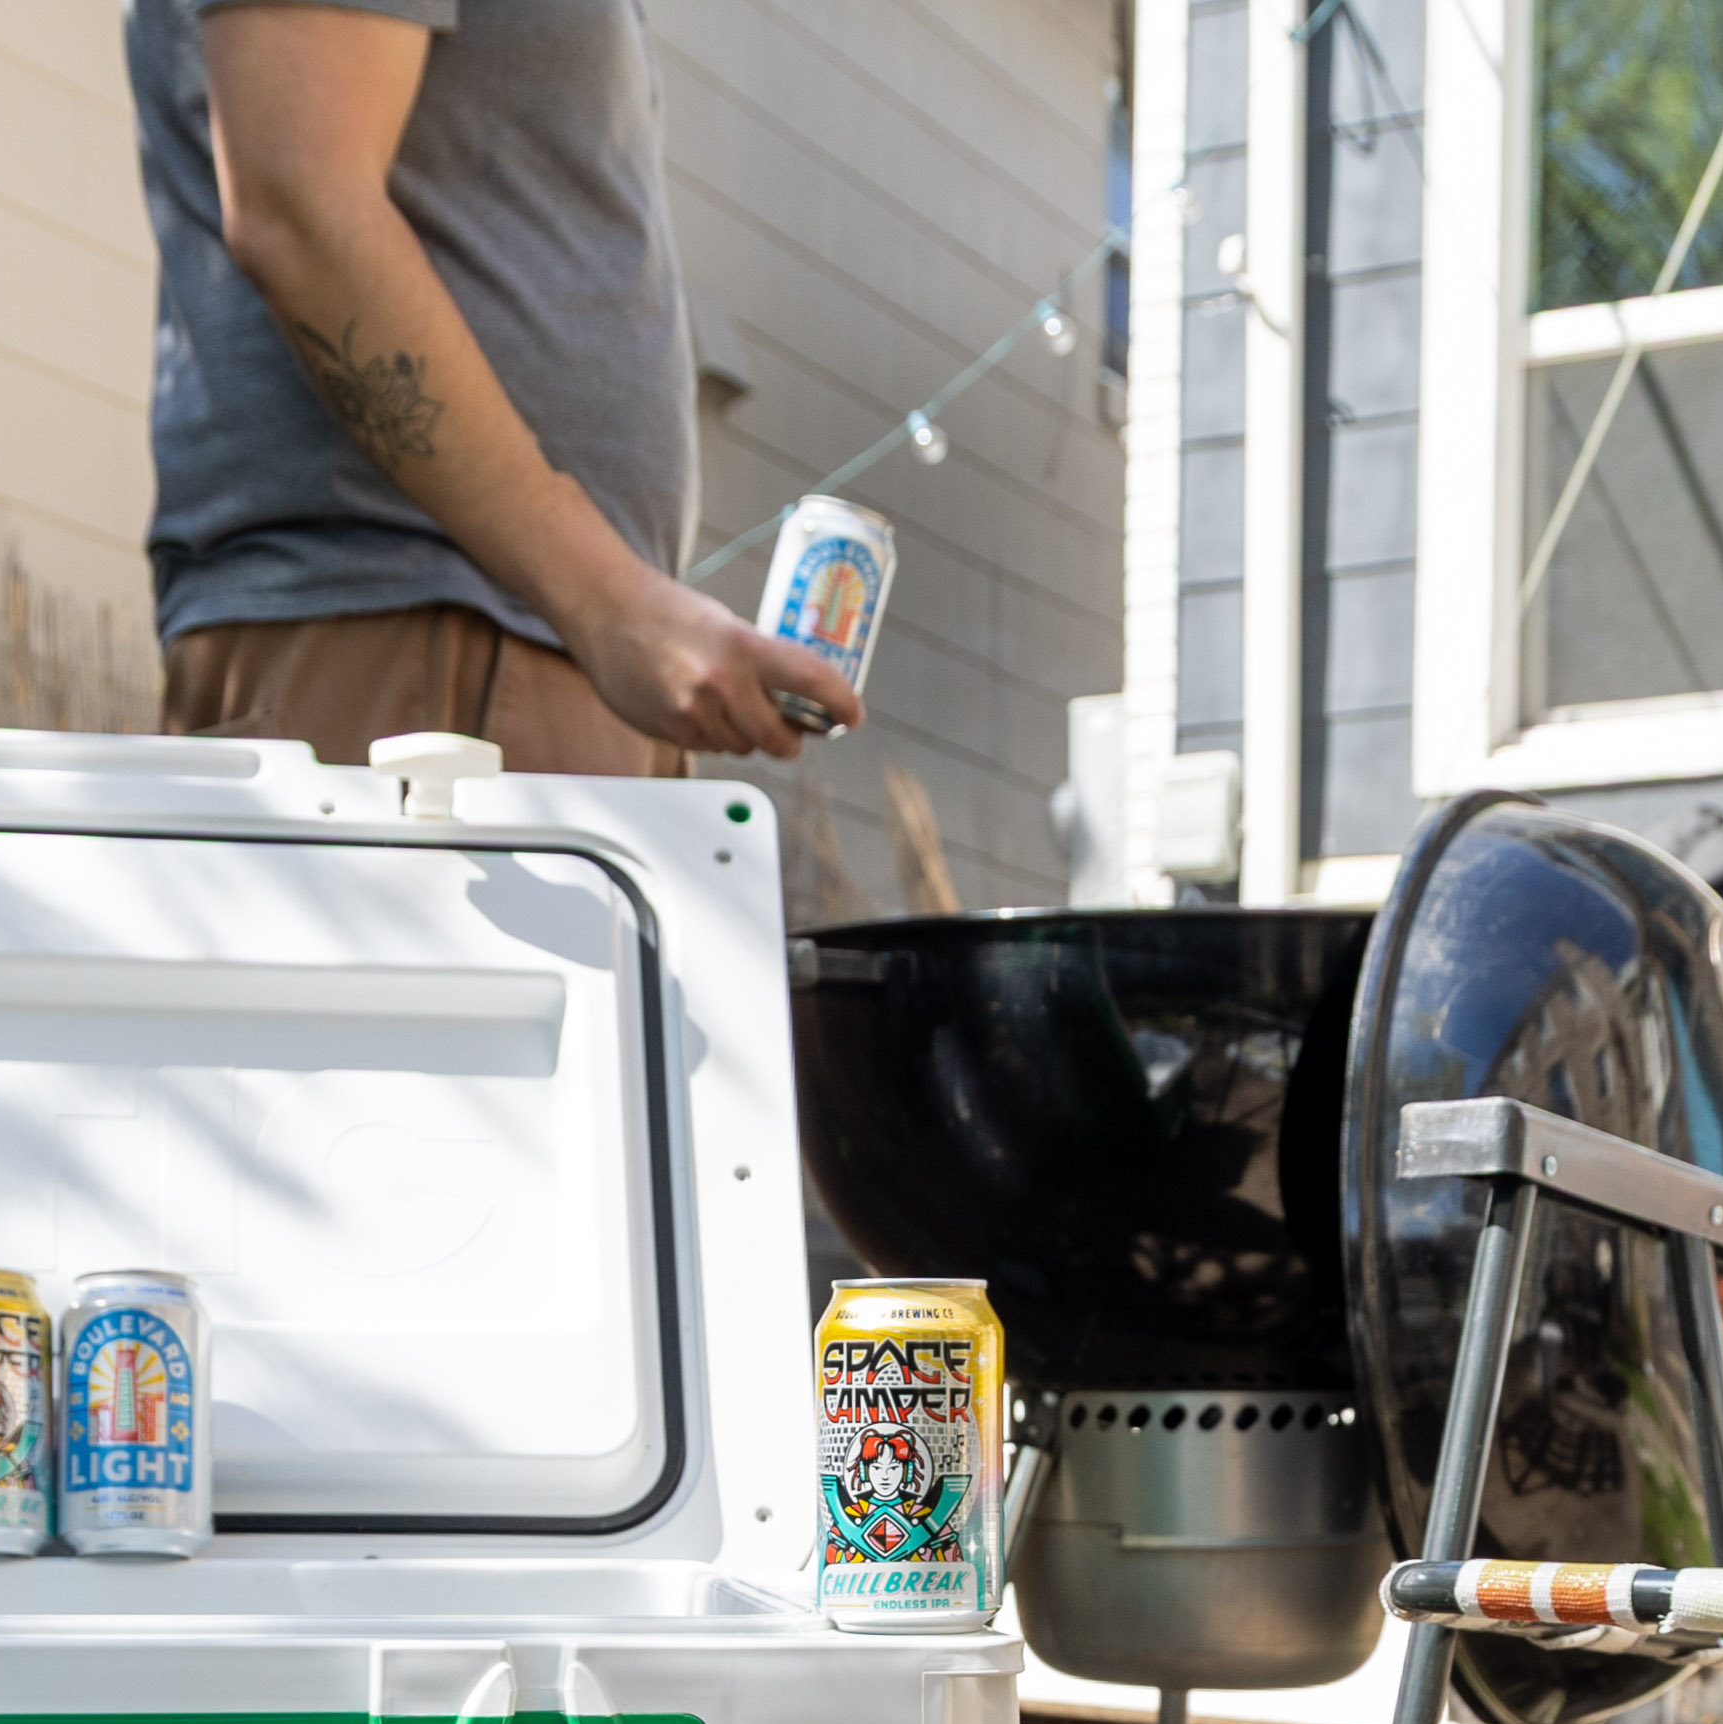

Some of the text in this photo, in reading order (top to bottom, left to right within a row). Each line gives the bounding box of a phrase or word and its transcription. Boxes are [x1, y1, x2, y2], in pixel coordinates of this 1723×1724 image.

[890, 1309, 939, 1319] BREWING
[72, 1313, 188, 1379] BOULEVARD
[823, 1337, 973, 1385] SPACE
[823, 1388, 970, 1423] CAMPER
[71, 1450, 189, 1485] LIGHT
[823, 1571, 968, 1597] CHILLBREAK
[873, 1599, 950, 1609] ENDLESS IPA
